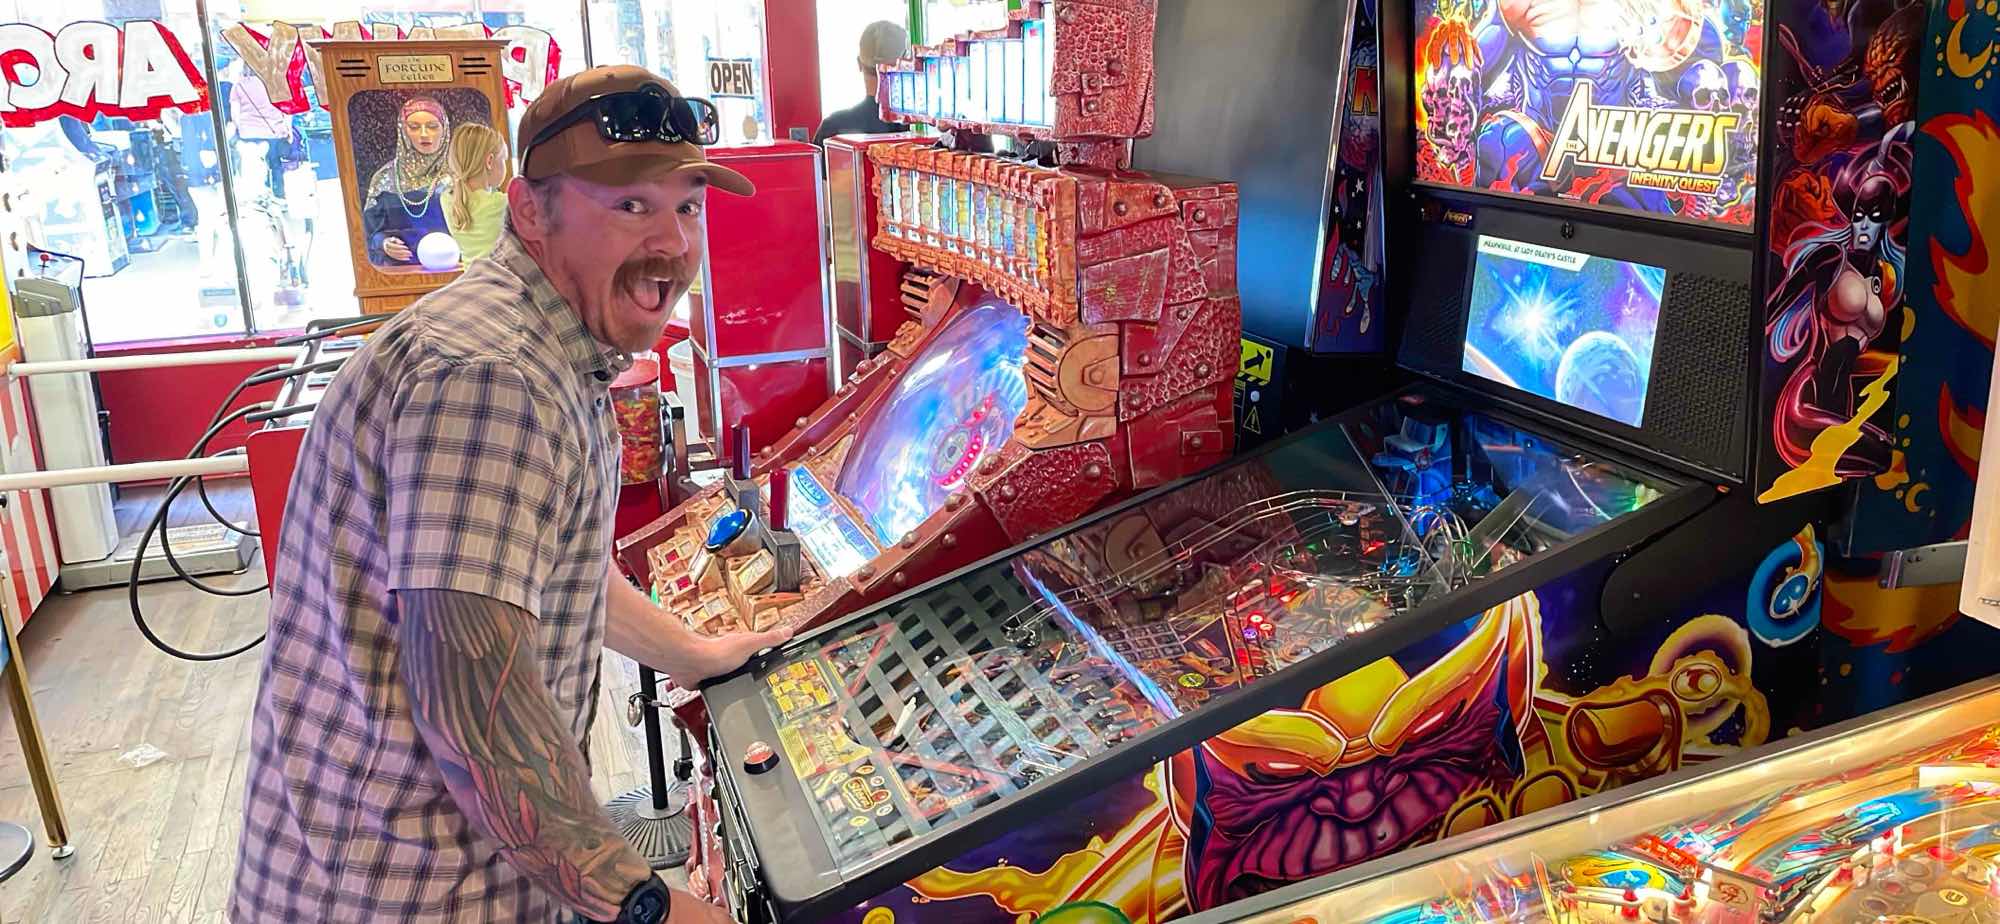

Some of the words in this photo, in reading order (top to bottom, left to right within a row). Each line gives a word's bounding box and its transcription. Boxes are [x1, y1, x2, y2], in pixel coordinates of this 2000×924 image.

[711, 63, 752, 95] OPEN
[1541, 80, 1739, 179] AVENGERS
[1631, 171, 1678, 190] INFINITY
[1679, 176, 1720, 194] QUEST
